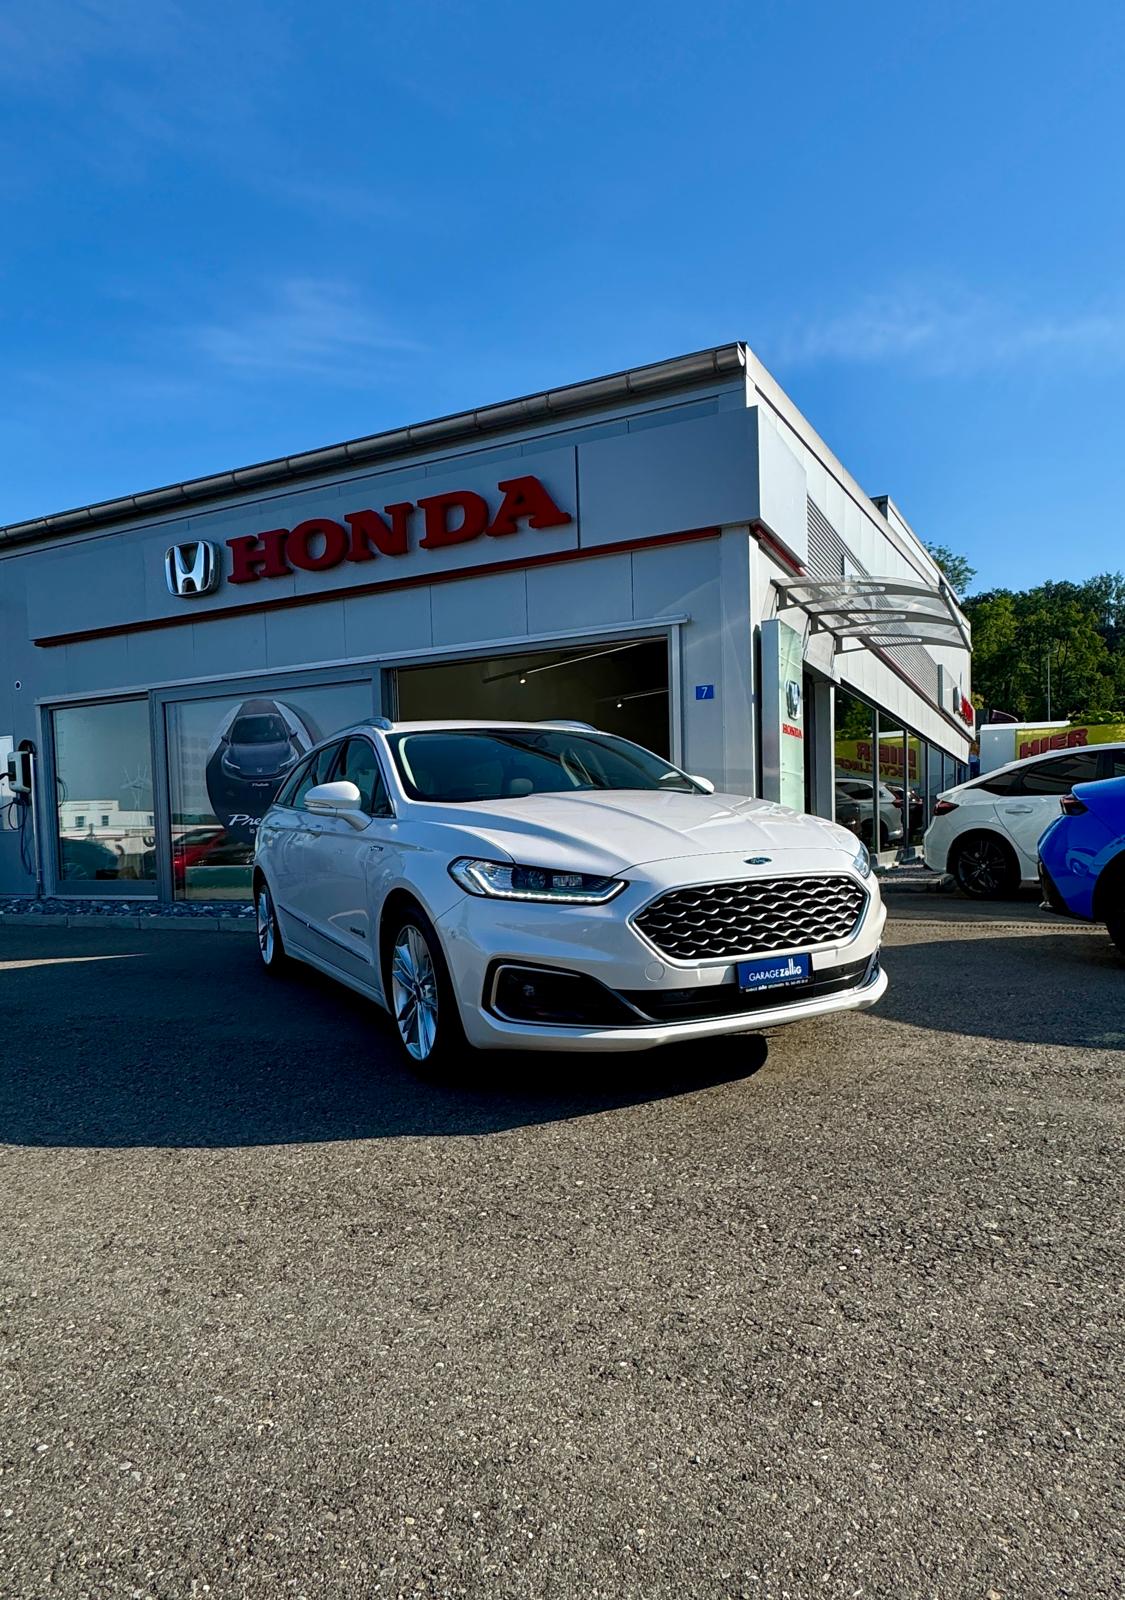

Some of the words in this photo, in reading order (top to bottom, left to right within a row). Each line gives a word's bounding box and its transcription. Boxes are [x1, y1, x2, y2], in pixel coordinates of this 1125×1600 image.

[225, 474, 572, 584] HONDA
[701, 686, 708, 699] 7
[782, 723, 803, 739] HONDA
[1019, 728, 1089, 760] HIER
[748, 968, 780, 982] GARAGE
